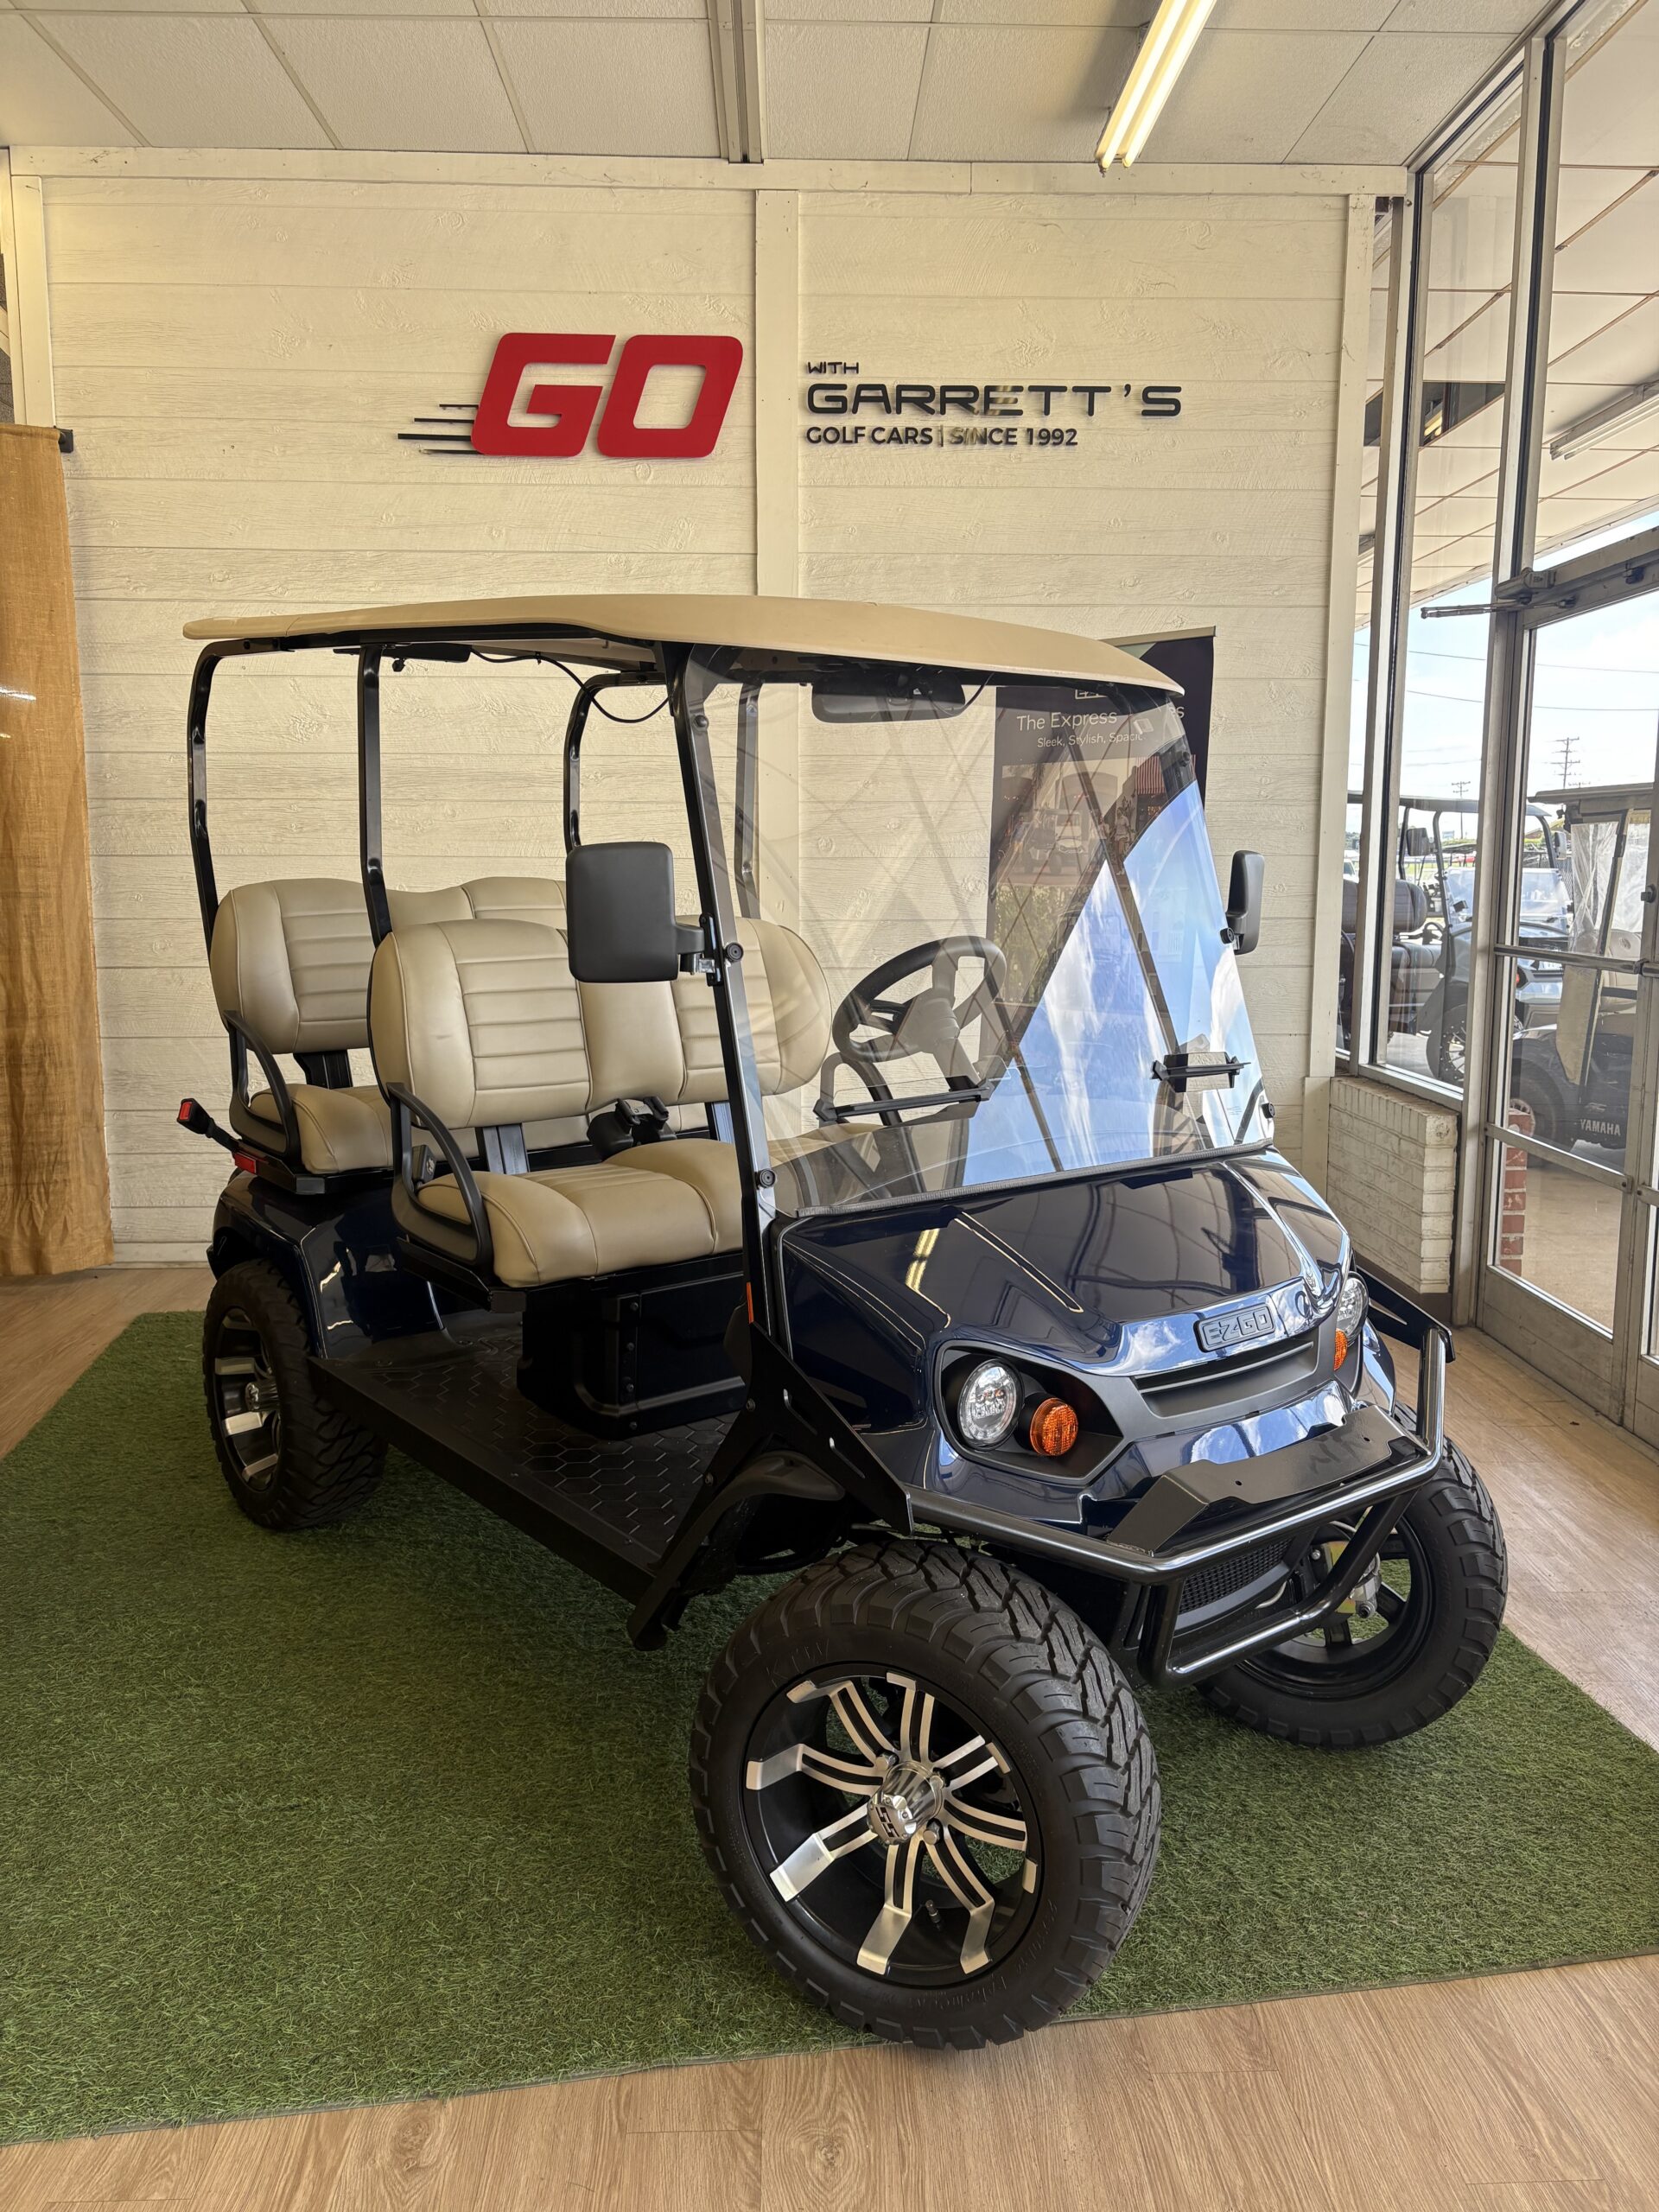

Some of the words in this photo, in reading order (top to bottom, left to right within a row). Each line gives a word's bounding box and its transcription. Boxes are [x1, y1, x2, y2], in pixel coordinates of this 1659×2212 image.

[807, 361, 859, 374] WITH
[471, 333, 743, 457] GO
[807, 383, 1182, 416] GARRETT'S
[806, 426, 866, 444] GOLF
[871, 427, 933, 445] CARS
[949, 427, 1018, 445] SINCE
[1026, 428, 1078, 446] 1992
[1016, 715, 1046, 731] The
[1051, 711, 1117, 729] Express
[1037, 735, 1065, 748] Sleek,
[1580, 1119, 1621, 1136] YAMAHA
